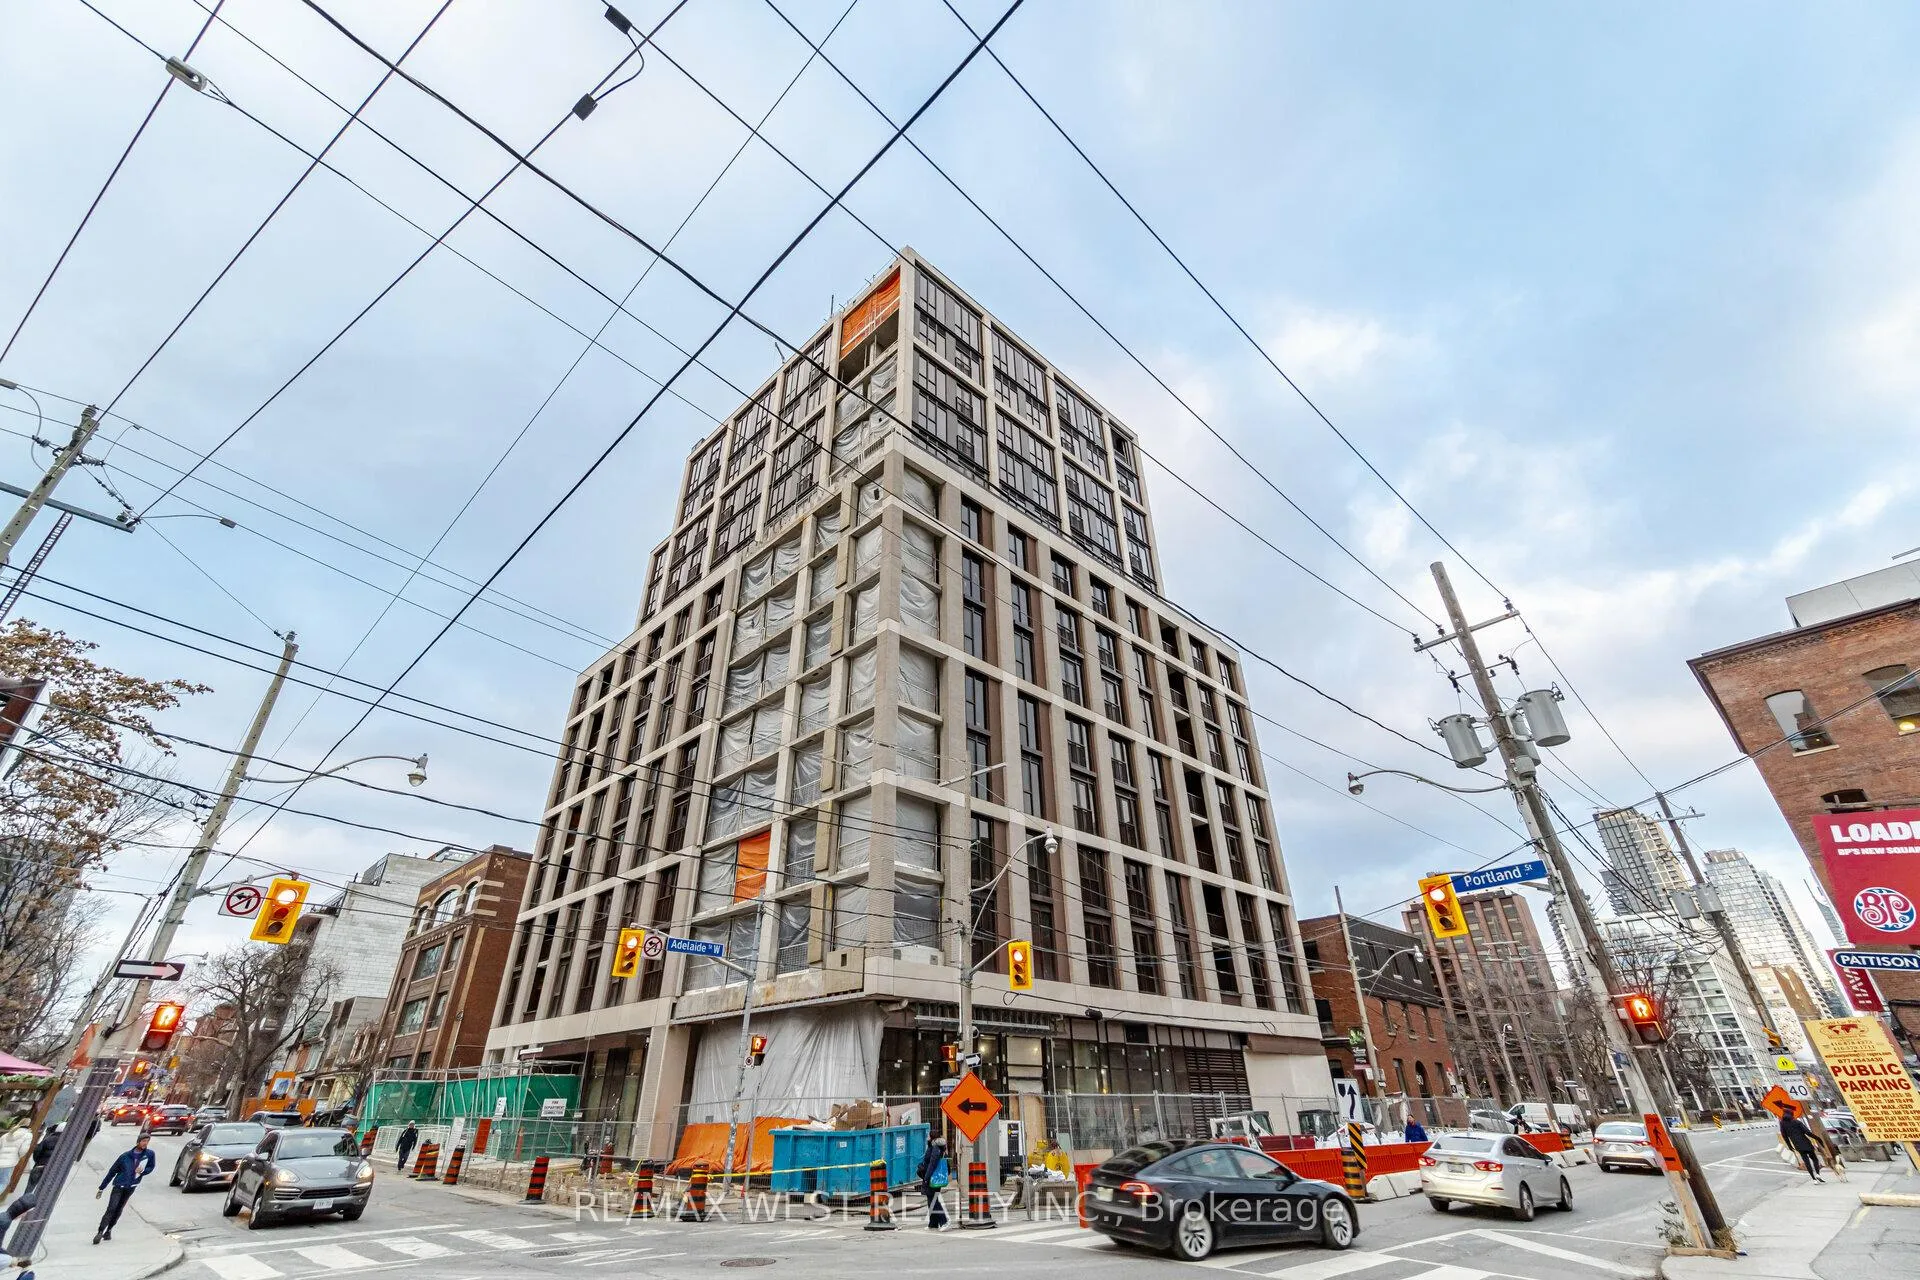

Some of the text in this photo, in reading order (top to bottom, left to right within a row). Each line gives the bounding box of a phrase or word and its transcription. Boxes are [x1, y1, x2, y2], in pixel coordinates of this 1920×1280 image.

[1464, 866, 1521, 887] Portland
[671, 940, 706, 952] Adelaide
[713, 945, 720, 954] W
[1840, 955, 1918, 968] PATTISON
[1830, 1063, 1901, 1077] PUBLIC
[1789, 1085, 1808, 1096] 40
[1838, 1078, 1911, 1092] PARKING
